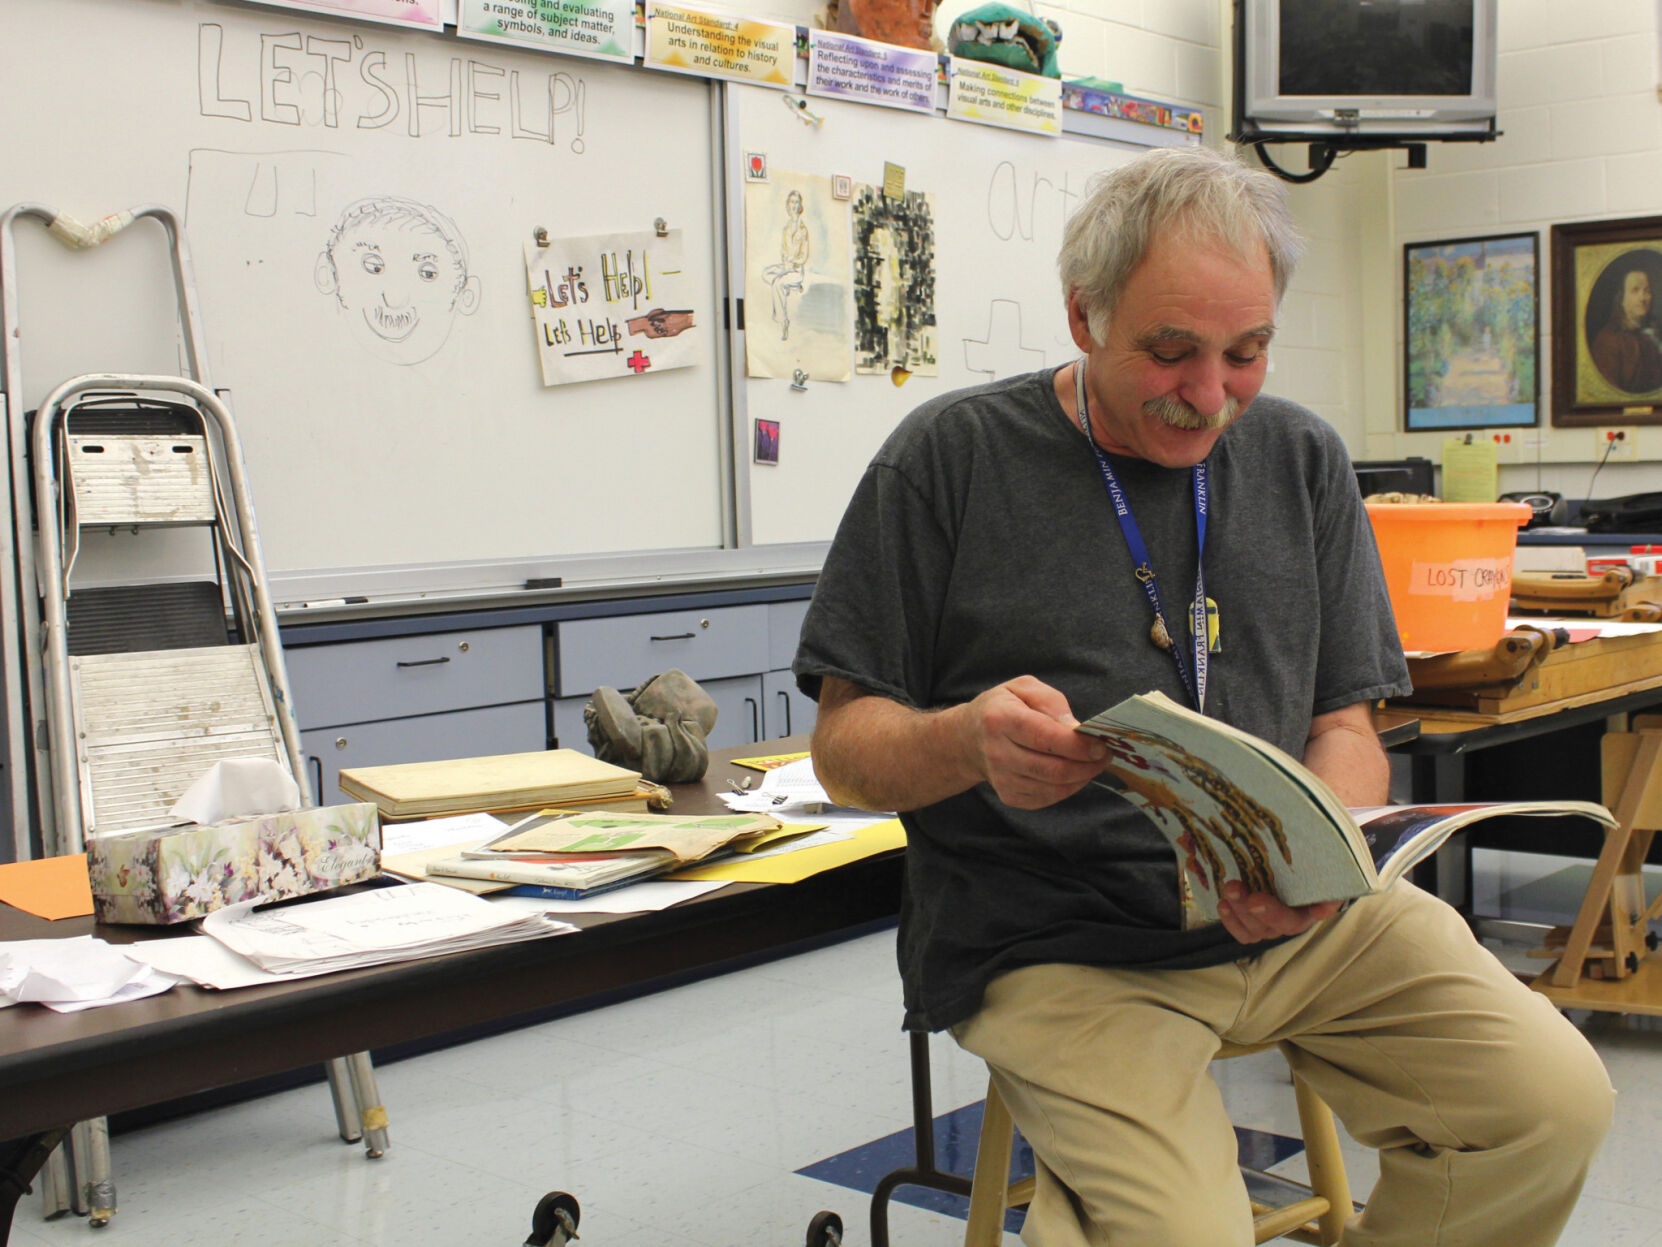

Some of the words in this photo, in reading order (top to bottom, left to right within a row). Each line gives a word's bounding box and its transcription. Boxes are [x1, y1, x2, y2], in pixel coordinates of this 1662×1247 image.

[483, 3, 490, 12] a
[493, 4, 524, 19] range
[526, 8, 538, 20] of
[540, 11, 579, 28] subject
[581, 17, 615, 36] matter,
[541, 0, 560, 10] and
[562, 1, 614, 22] evaluating
[655, 7, 685, 21] National
[686, 13, 698, 23] Art
[497, 18, 545, 37] symbols,
[548, 26, 568, 39] and
[570, 29, 601, 45] ideas.
[667, 21, 736, 46] Understanding
[738, 34, 752, 47] the
[754, 38, 779, 52] visual
[817, 39, 845, 51] National
[668, 36, 687, 48] arts
[689, 39, 698, 50] in
[700, 40, 734, 56] relation
[736, 48, 746, 59] to
[747, 49, 778, 66] history
[693, 54, 711, 66] and
[712, 56, 751, 73] cultures.
[817, 50, 858, 68] Reflecting
[860, 60, 880, 71] upon
[881, 63, 895, 73] and
[896, 66, 932, 82] assessing
[817, 62, 830, 73] the
[831, 65, 886, 83] characteristics
[888, 76, 901, 86] and
[902, 78, 924, 90] merits
[925, 82, 933, 91] of
[199, 23, 400, 129] LET'S
[404, 52, 586, 155] HELP!
[816, 75, 834, 87] their
[835, 79, 853, 89] work
[854, 82, 869, 93] and
[870, 84, 881, 95] the
[882, 87, 900, 97] work
[901, 90, 909, 99] of
[959, 81, 986, 97] Making
[987, 88, 1028, 103] connections
[1029, 95, 1055, 109] between
[958, 93, 978, 105] visual
[979, 98, 991, 108] arts
[992, 100, 1005, 110] and
[1006, 101, 1023, 113] other
[1023, 106, 1056, 120] disciplines.
[577, 316, 623, 355] Help
[1099, 459, 1129, 517] BENJAMIN
[1196, 462, 1207, 515] FRANKLIN
[1428, 567, 1468, 589] LOST
